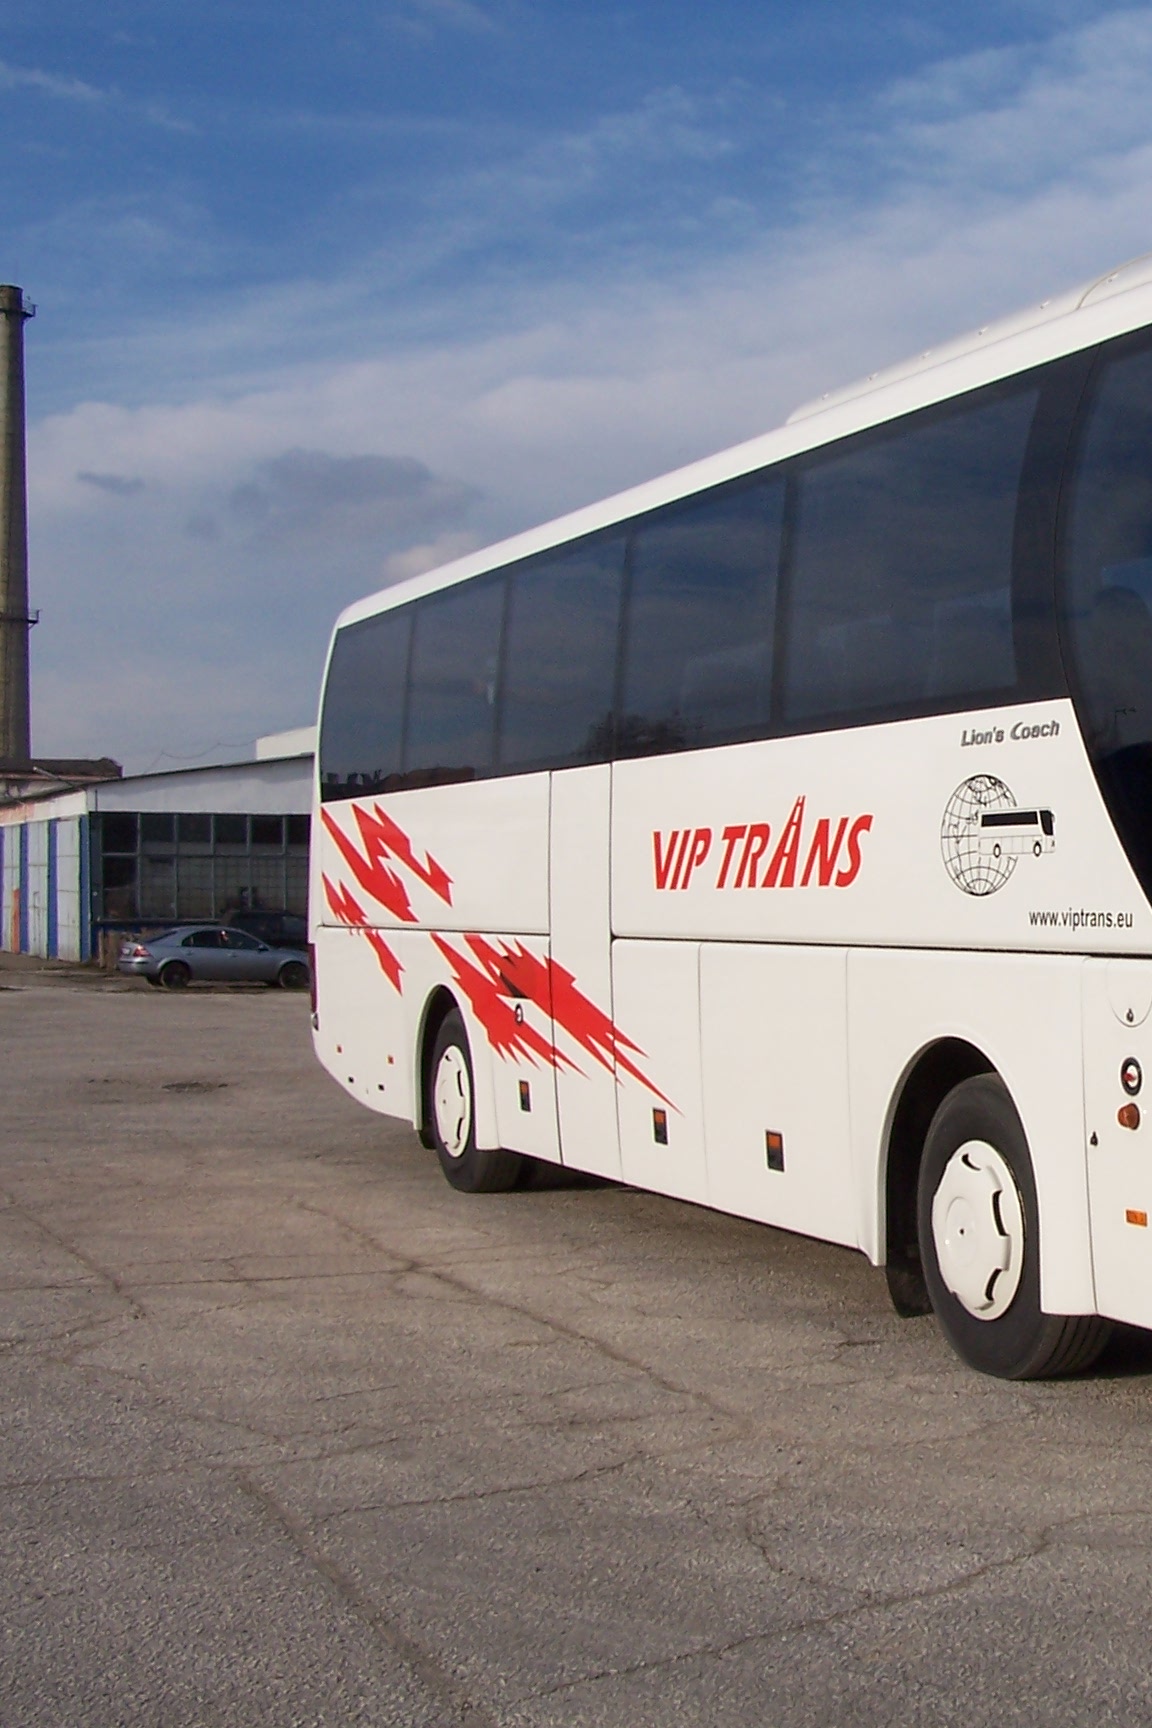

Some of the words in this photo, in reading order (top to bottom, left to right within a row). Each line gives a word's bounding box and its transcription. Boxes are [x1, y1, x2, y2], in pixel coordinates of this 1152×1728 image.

[961, 727, 1004, 748] Lion's
[1010, 720, 1060, 741] Coach
[653, 828, 711, 890] VIP
[716, 795, 874, 889] TRANS
[1029, 907, 1133, 931] www.viptrans.eu
